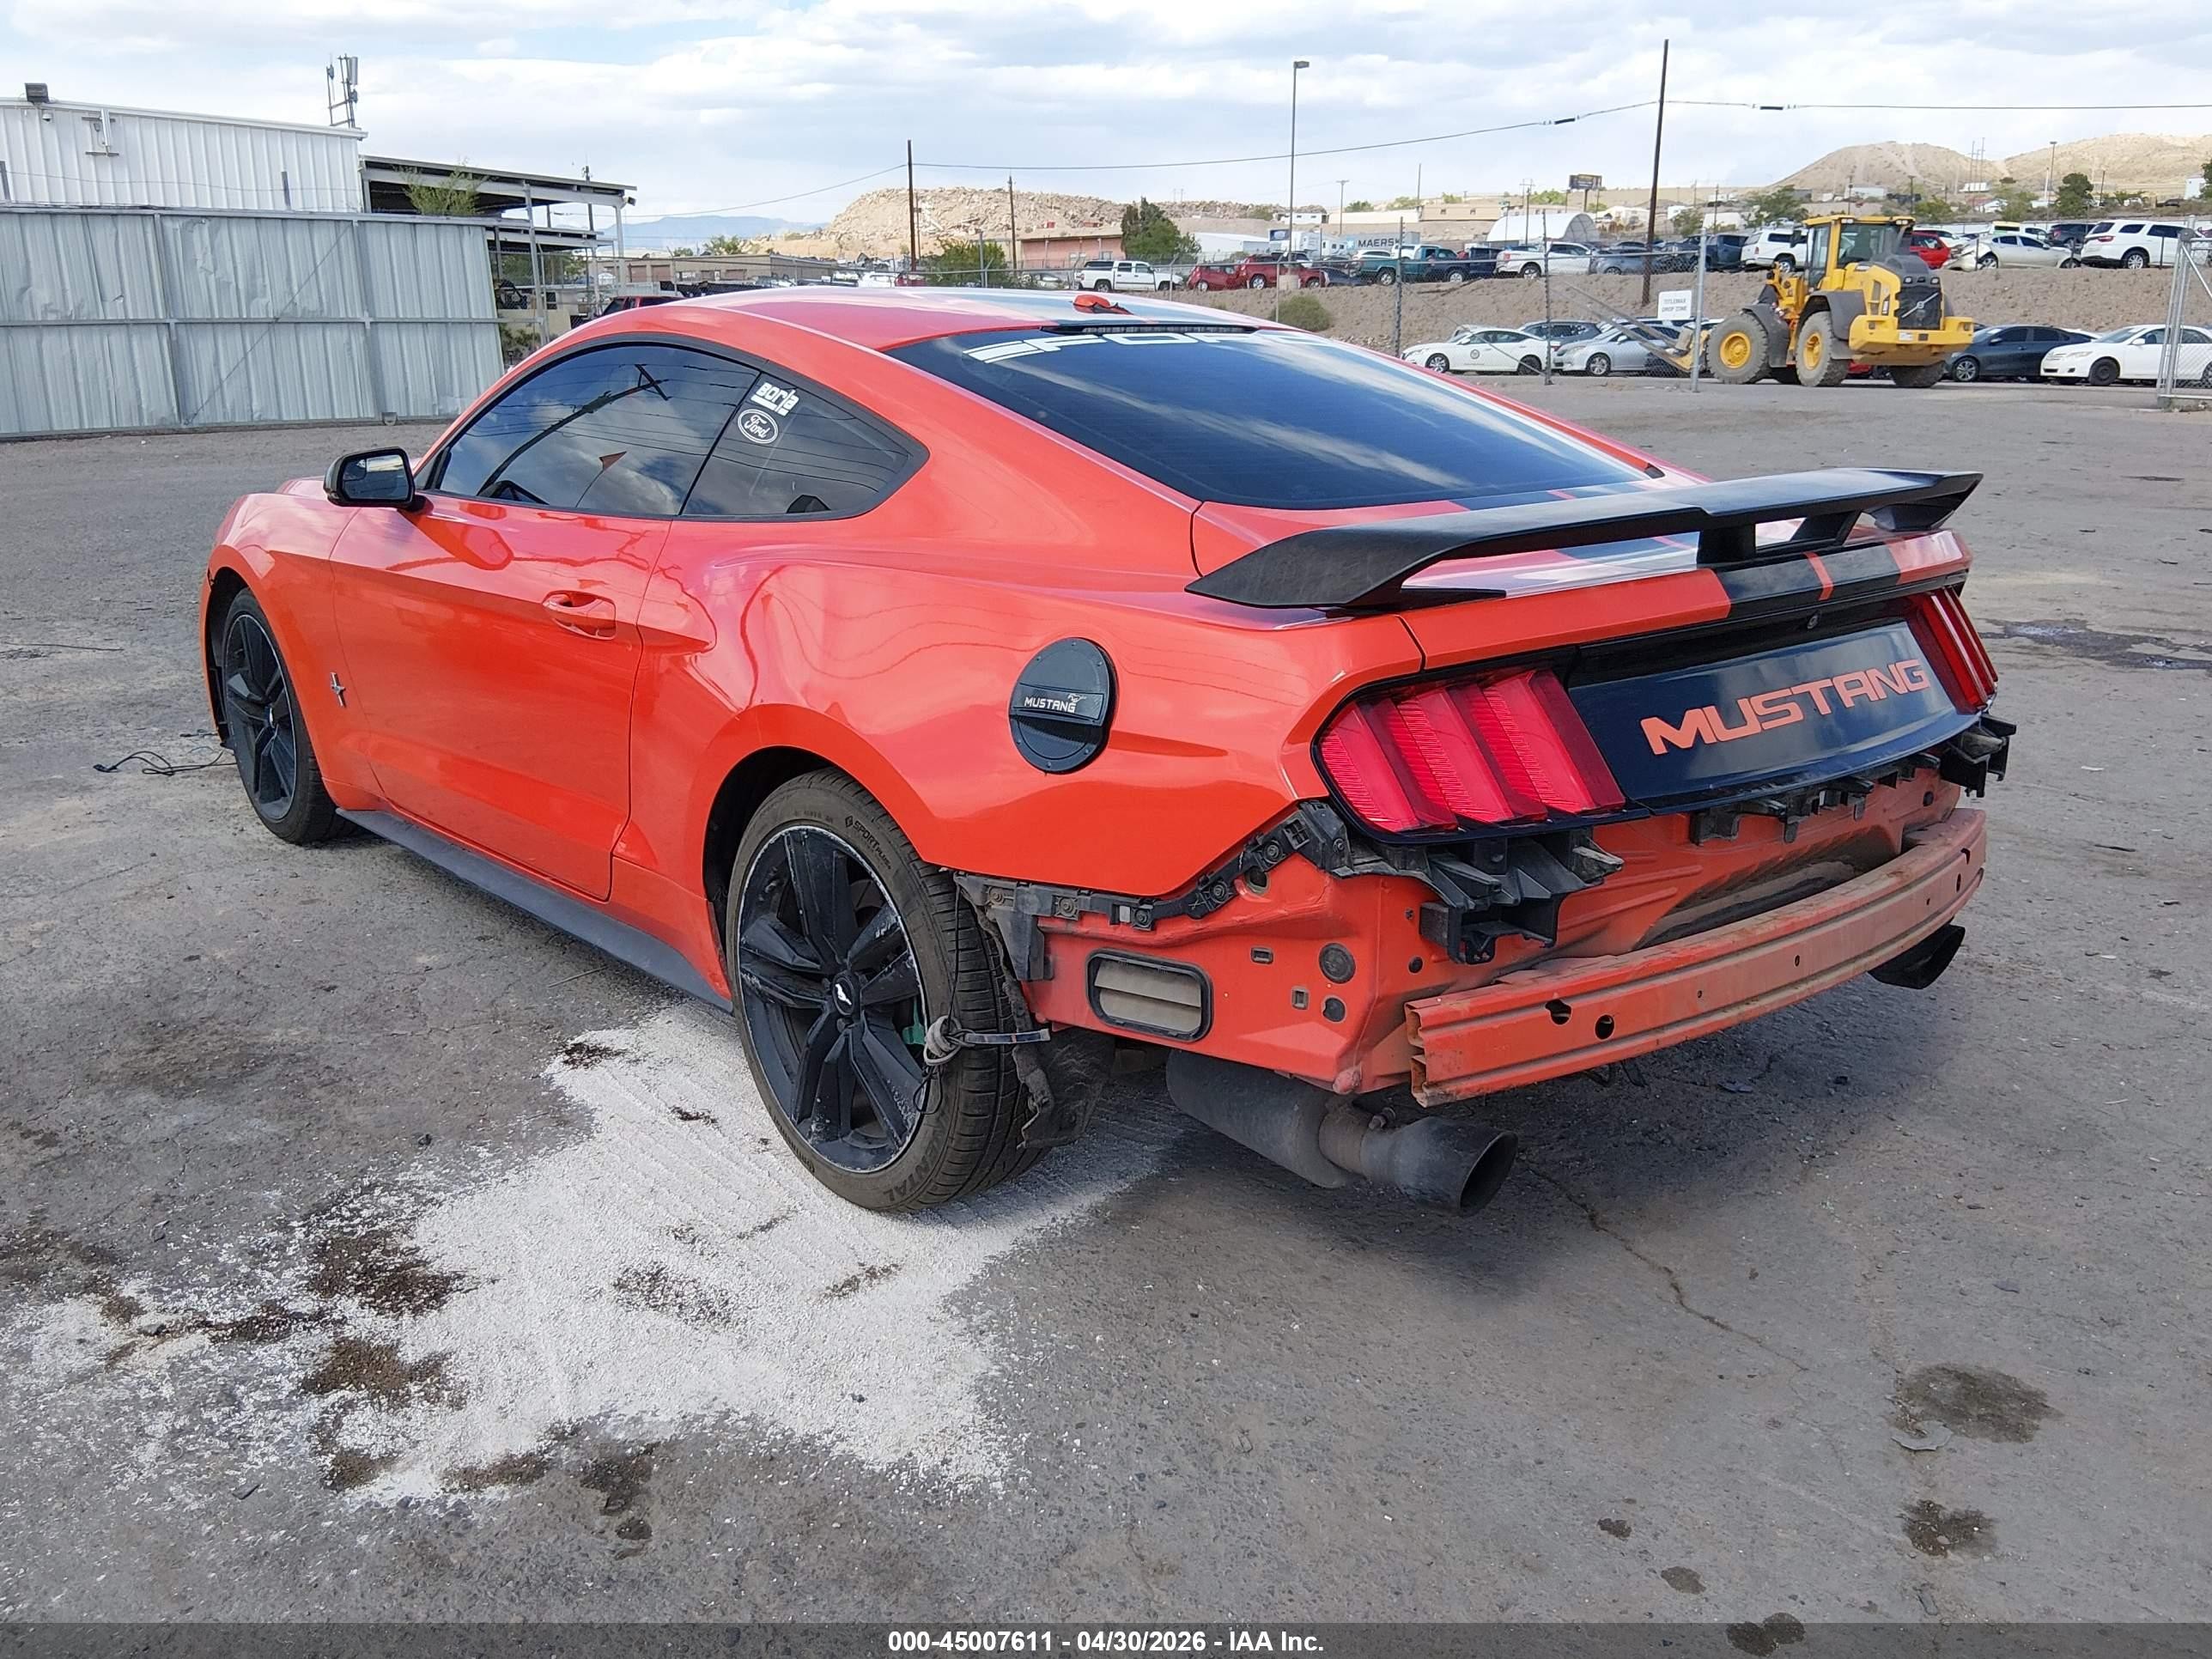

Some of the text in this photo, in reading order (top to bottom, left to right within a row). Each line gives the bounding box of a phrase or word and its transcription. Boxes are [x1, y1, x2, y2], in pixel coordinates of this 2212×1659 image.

[744, 415, 770, 438] Ford
[1024, 696, 1076, 714] MUSTANG
[1640, 659, 1930, 756] MUSTANG
[853, 821, 879, 848] SPORT
